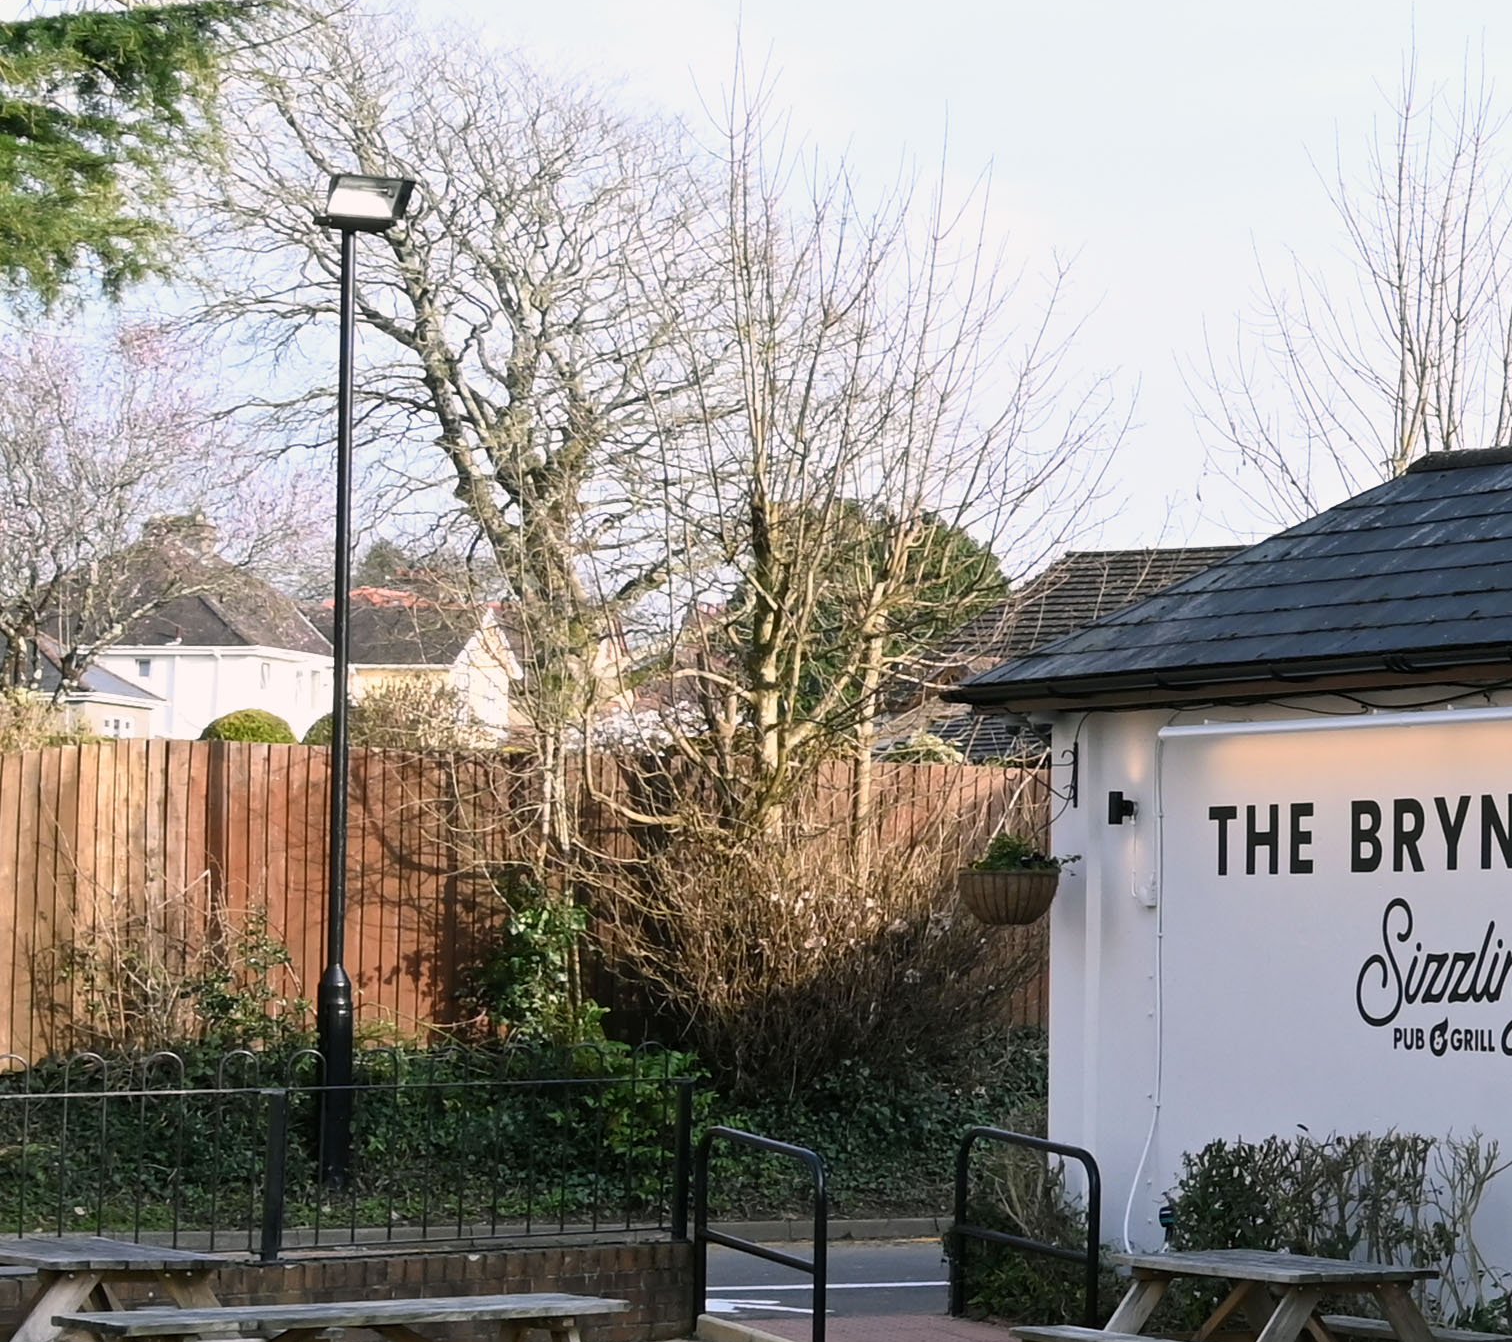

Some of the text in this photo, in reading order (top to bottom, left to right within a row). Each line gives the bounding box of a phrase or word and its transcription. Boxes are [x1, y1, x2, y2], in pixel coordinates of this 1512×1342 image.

[1208, 802, 1314, 876] THE
[1393, 1027, 1425, 1050] PUB
[1450, 1028, 1496, 1052] GRILL
